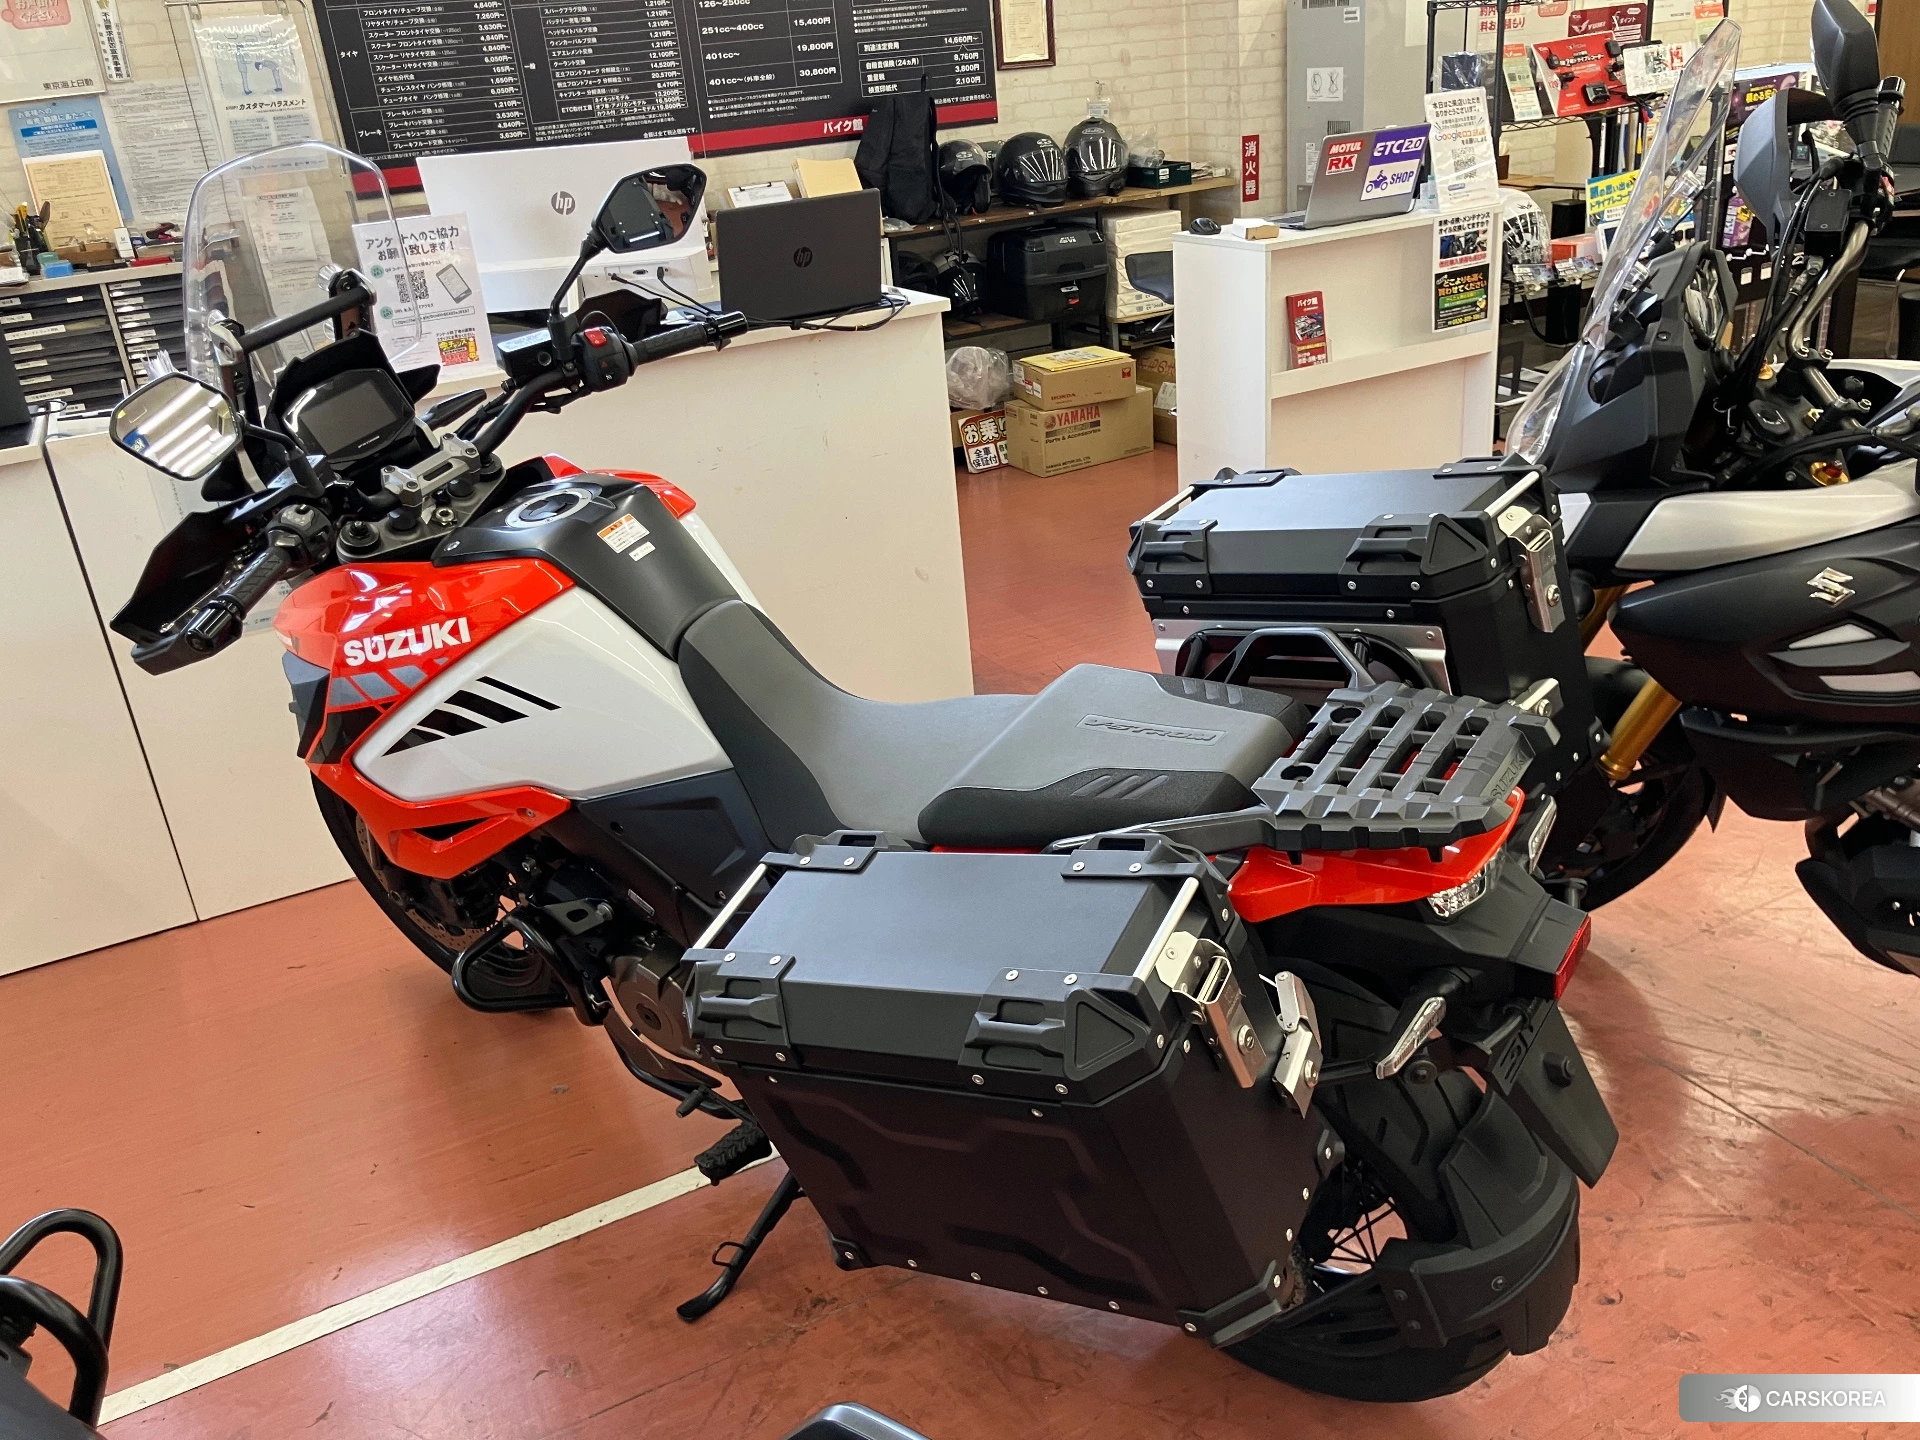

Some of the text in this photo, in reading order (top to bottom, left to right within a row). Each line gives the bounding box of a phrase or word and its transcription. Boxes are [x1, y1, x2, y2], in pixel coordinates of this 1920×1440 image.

[702, 16, 831, 35] 251cc~400cc 15,400円
[368, 31, 394, 39] スクーター
[371, 42, 397, 50] スクーター
[705, 42, 834, 61] 401cc~ 19,800円
[864, 42, 900, 51] 別途法定費用
[340, 50, 358, 59] タイヤ
[373, 53, 399, 61] スクーター
[953, 52, 979, 61] 8,760円
[376, 64, 402, 72] スクーター
[799, 66, 836, 77] 30,800円
[955, 64, 980, 73] 3,800円
[42, 78, 94, 91] 東京海上日動
[956, 76, 981, 84] 2,100円
[380, 84, 426, 93] チューブレスタイヤ
[239, 99, 307, 111] カスタマーハラスメント
[383, 95, 418, 104] チューブタイヤ
[823, 118, 863, 134] バイク館
[358, 129, 382, 137] ブレーキ
[1329, 141, 1362, 154] MOTUL
[1373, 138, 1423, 157] ETC 2.0
[1244, 141, 1257, 195] 消火器
[1328, 155, 1356, 171] RK
[1389, 170, 1415, 185] SHOP
[552, 190, 574, 216] hp
[366, 225, 459, 250] アンケトへのご協力
[795, 248, 812, 267] hp
[1297, 297, 1318, 307] バイク館
[1057, 405, 1100, 426] YAMAHA
[1045, 437, 1061, 445] Parts
[974, 446, 992, 459] 全車
[973, 455, 998, 468] 保証付
[344, 616, 472, 667] SUZUKI
[1490, 751, 1526, 801] SUZUKI
